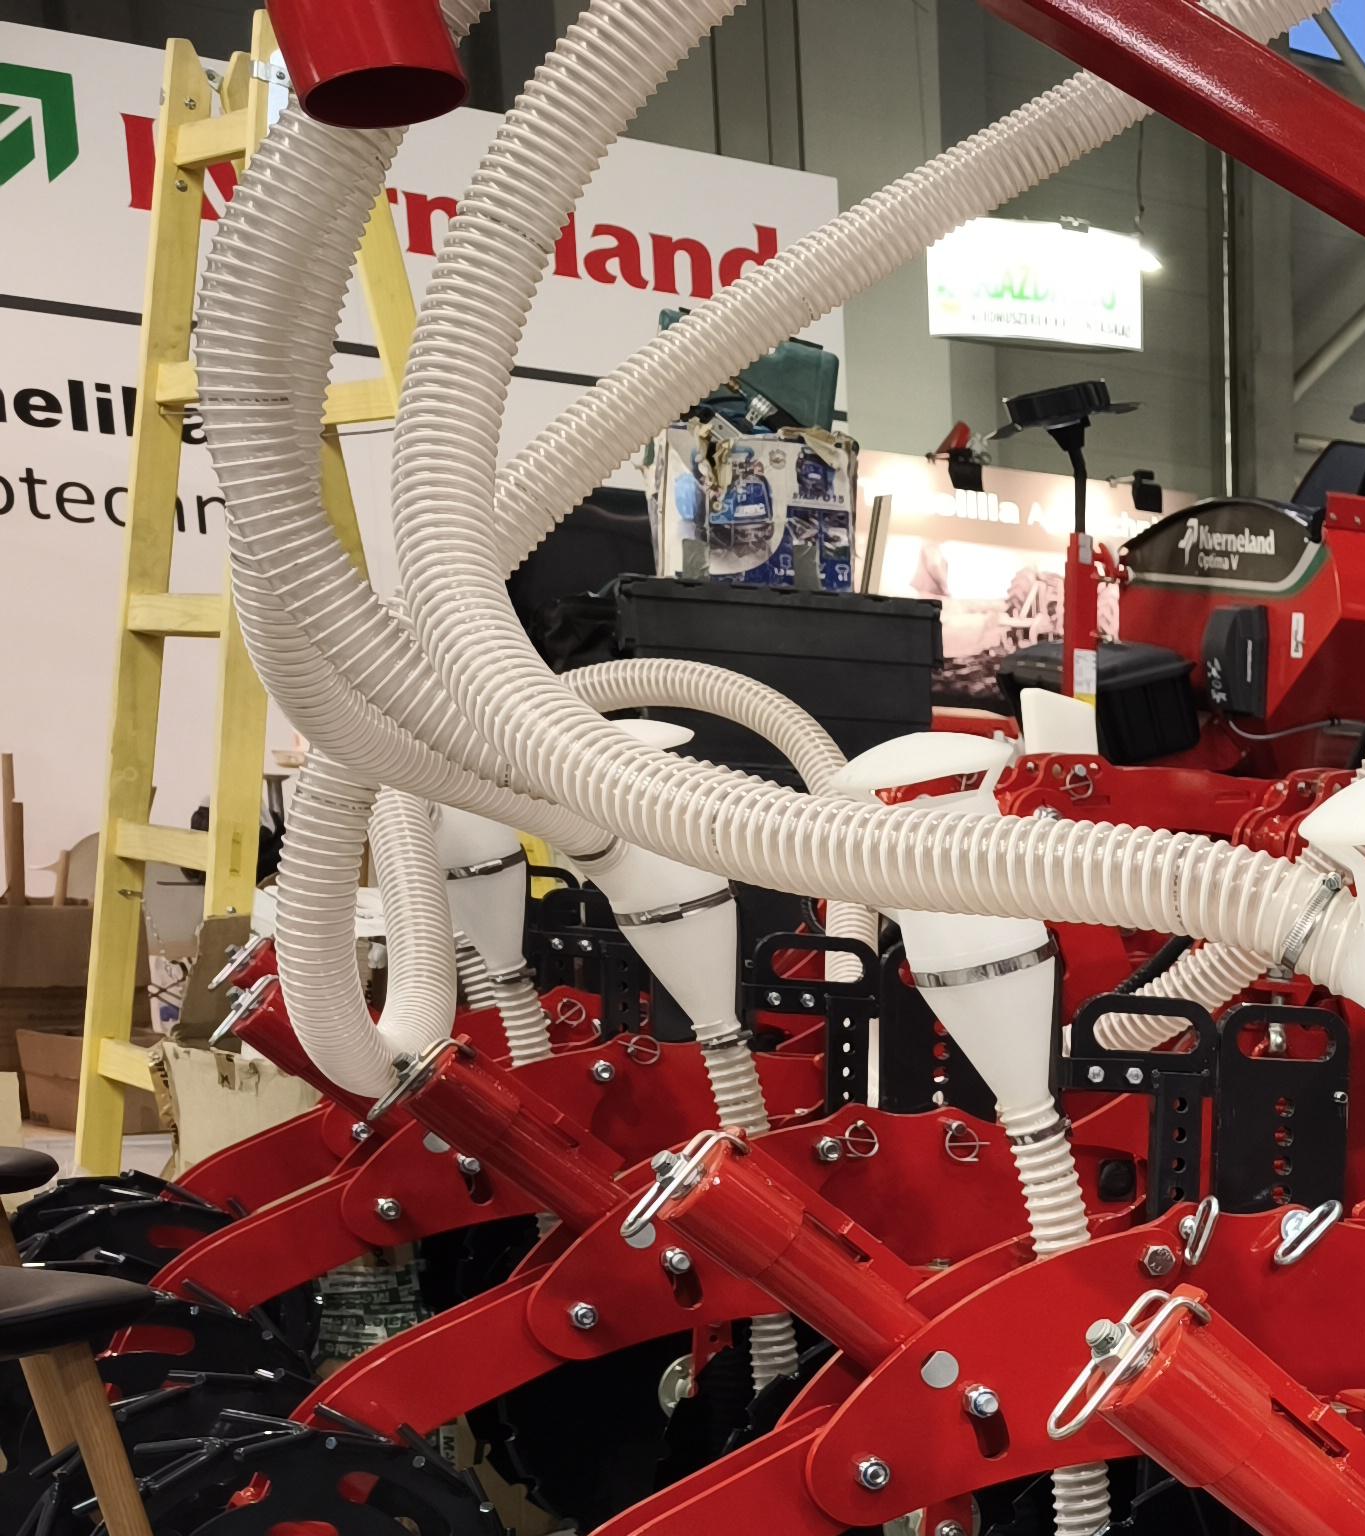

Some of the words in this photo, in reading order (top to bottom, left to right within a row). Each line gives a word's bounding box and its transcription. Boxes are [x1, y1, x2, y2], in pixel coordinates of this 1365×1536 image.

[1199, 525, 1276, 555] Kverneland
[1198, 551, 1229, 570] Optima
[1230, 554, 1239, 571] V
